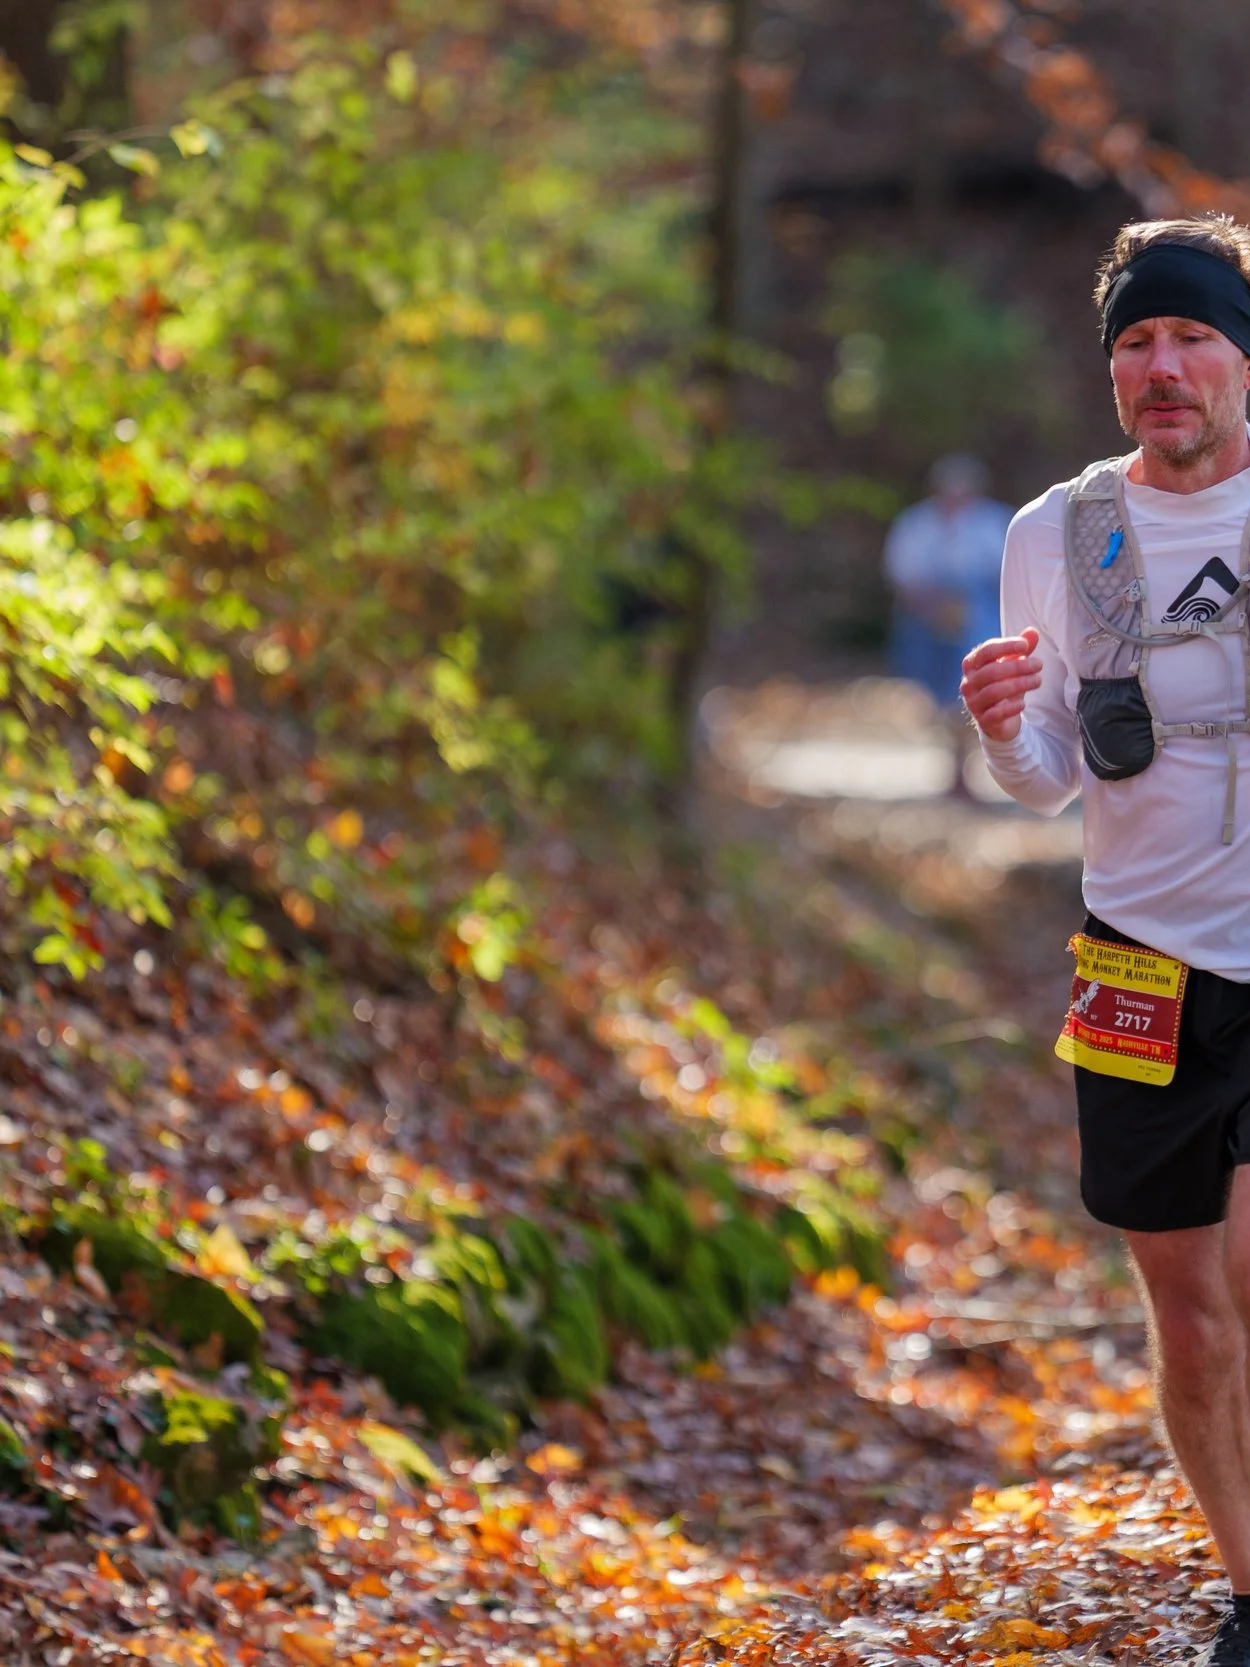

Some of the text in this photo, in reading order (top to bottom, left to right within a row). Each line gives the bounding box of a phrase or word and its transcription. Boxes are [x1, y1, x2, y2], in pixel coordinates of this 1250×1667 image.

[1083, 944, 1157, 970] THE HARPETH HILLS
[1091, 961, 1121, 977] MONKEY
[1123, 968, 1171, 986] MARATHON
[1114, 994, 1155, 1011] Thurman
[1114, 1011, 1151, 1031] 2717
[1117, 1037, 1148, 1051] NASHVILLE
[1151, 1044, 1161, 1056] TN
